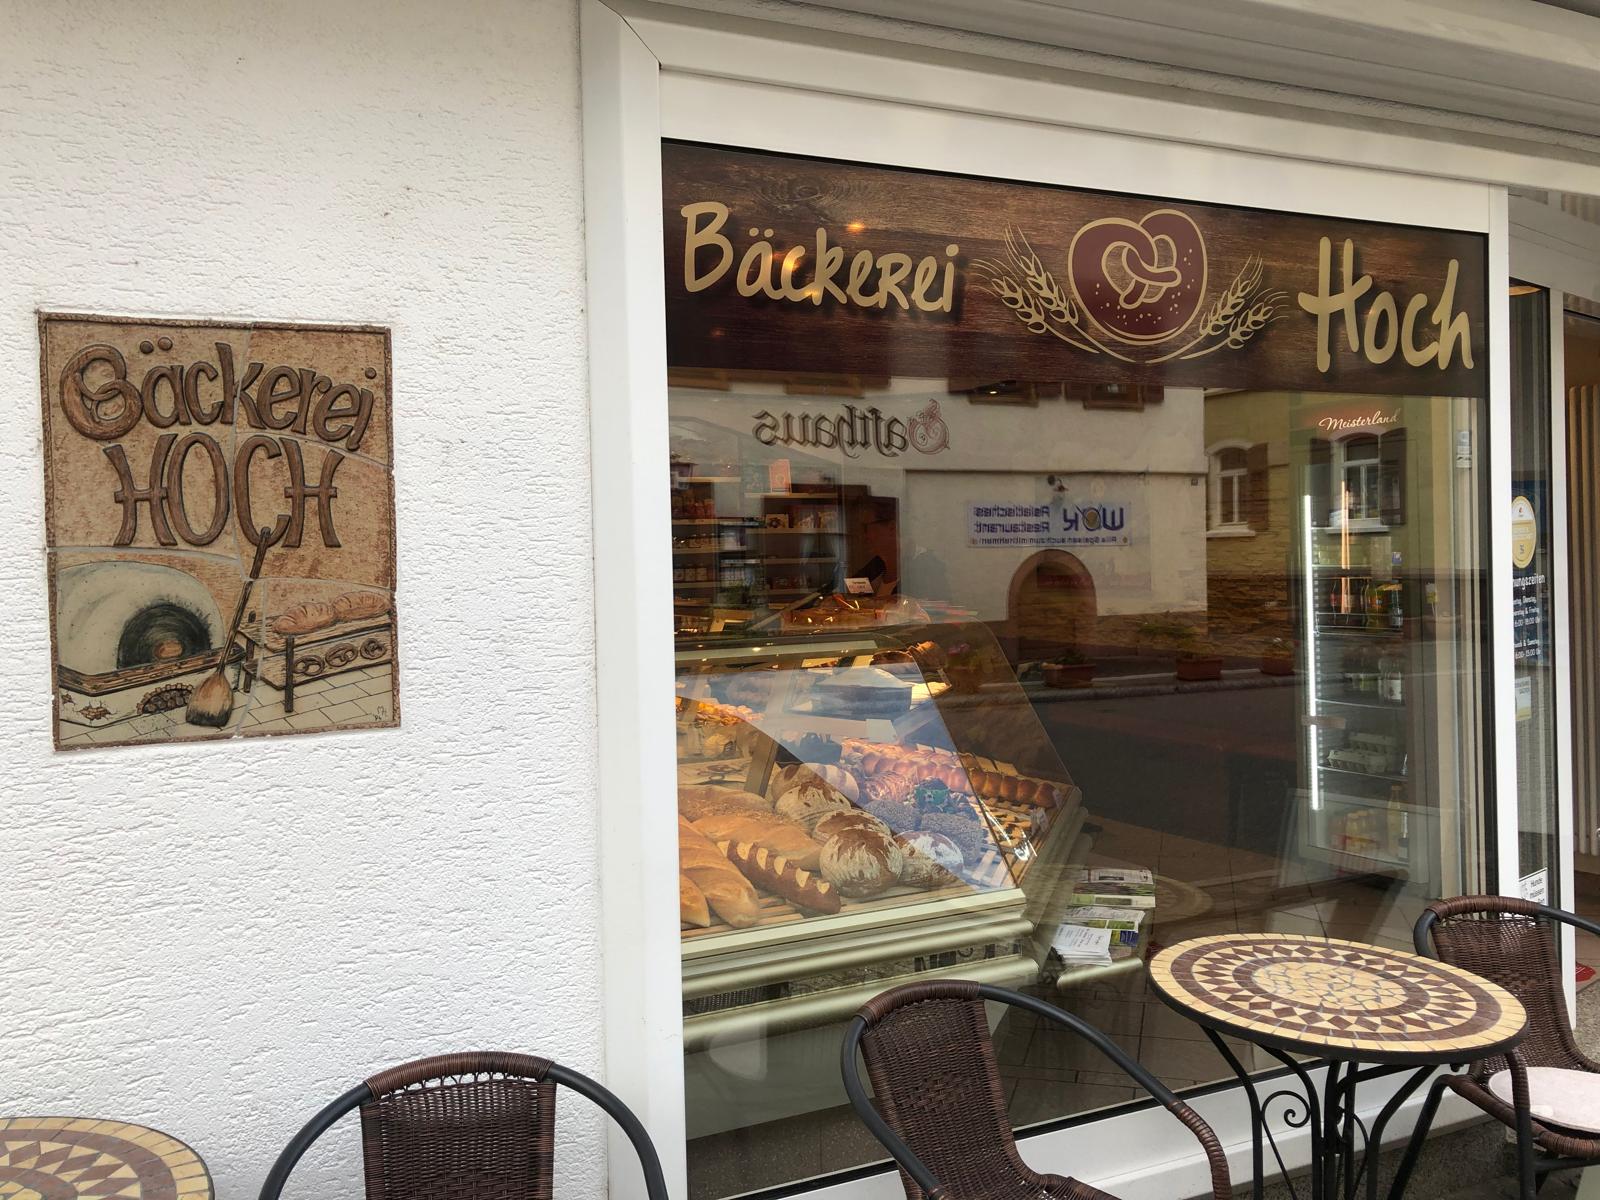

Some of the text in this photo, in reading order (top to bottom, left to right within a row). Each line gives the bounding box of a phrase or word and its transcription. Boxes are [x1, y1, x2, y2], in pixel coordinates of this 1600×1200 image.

[681, 201, 1474, 373] Bäckerei Hoch
[60, 336, 378, 451] Bäckerei
[1318, 408, 1401, 431] Meisterland
[102, 432, 345, 549] HOCH
